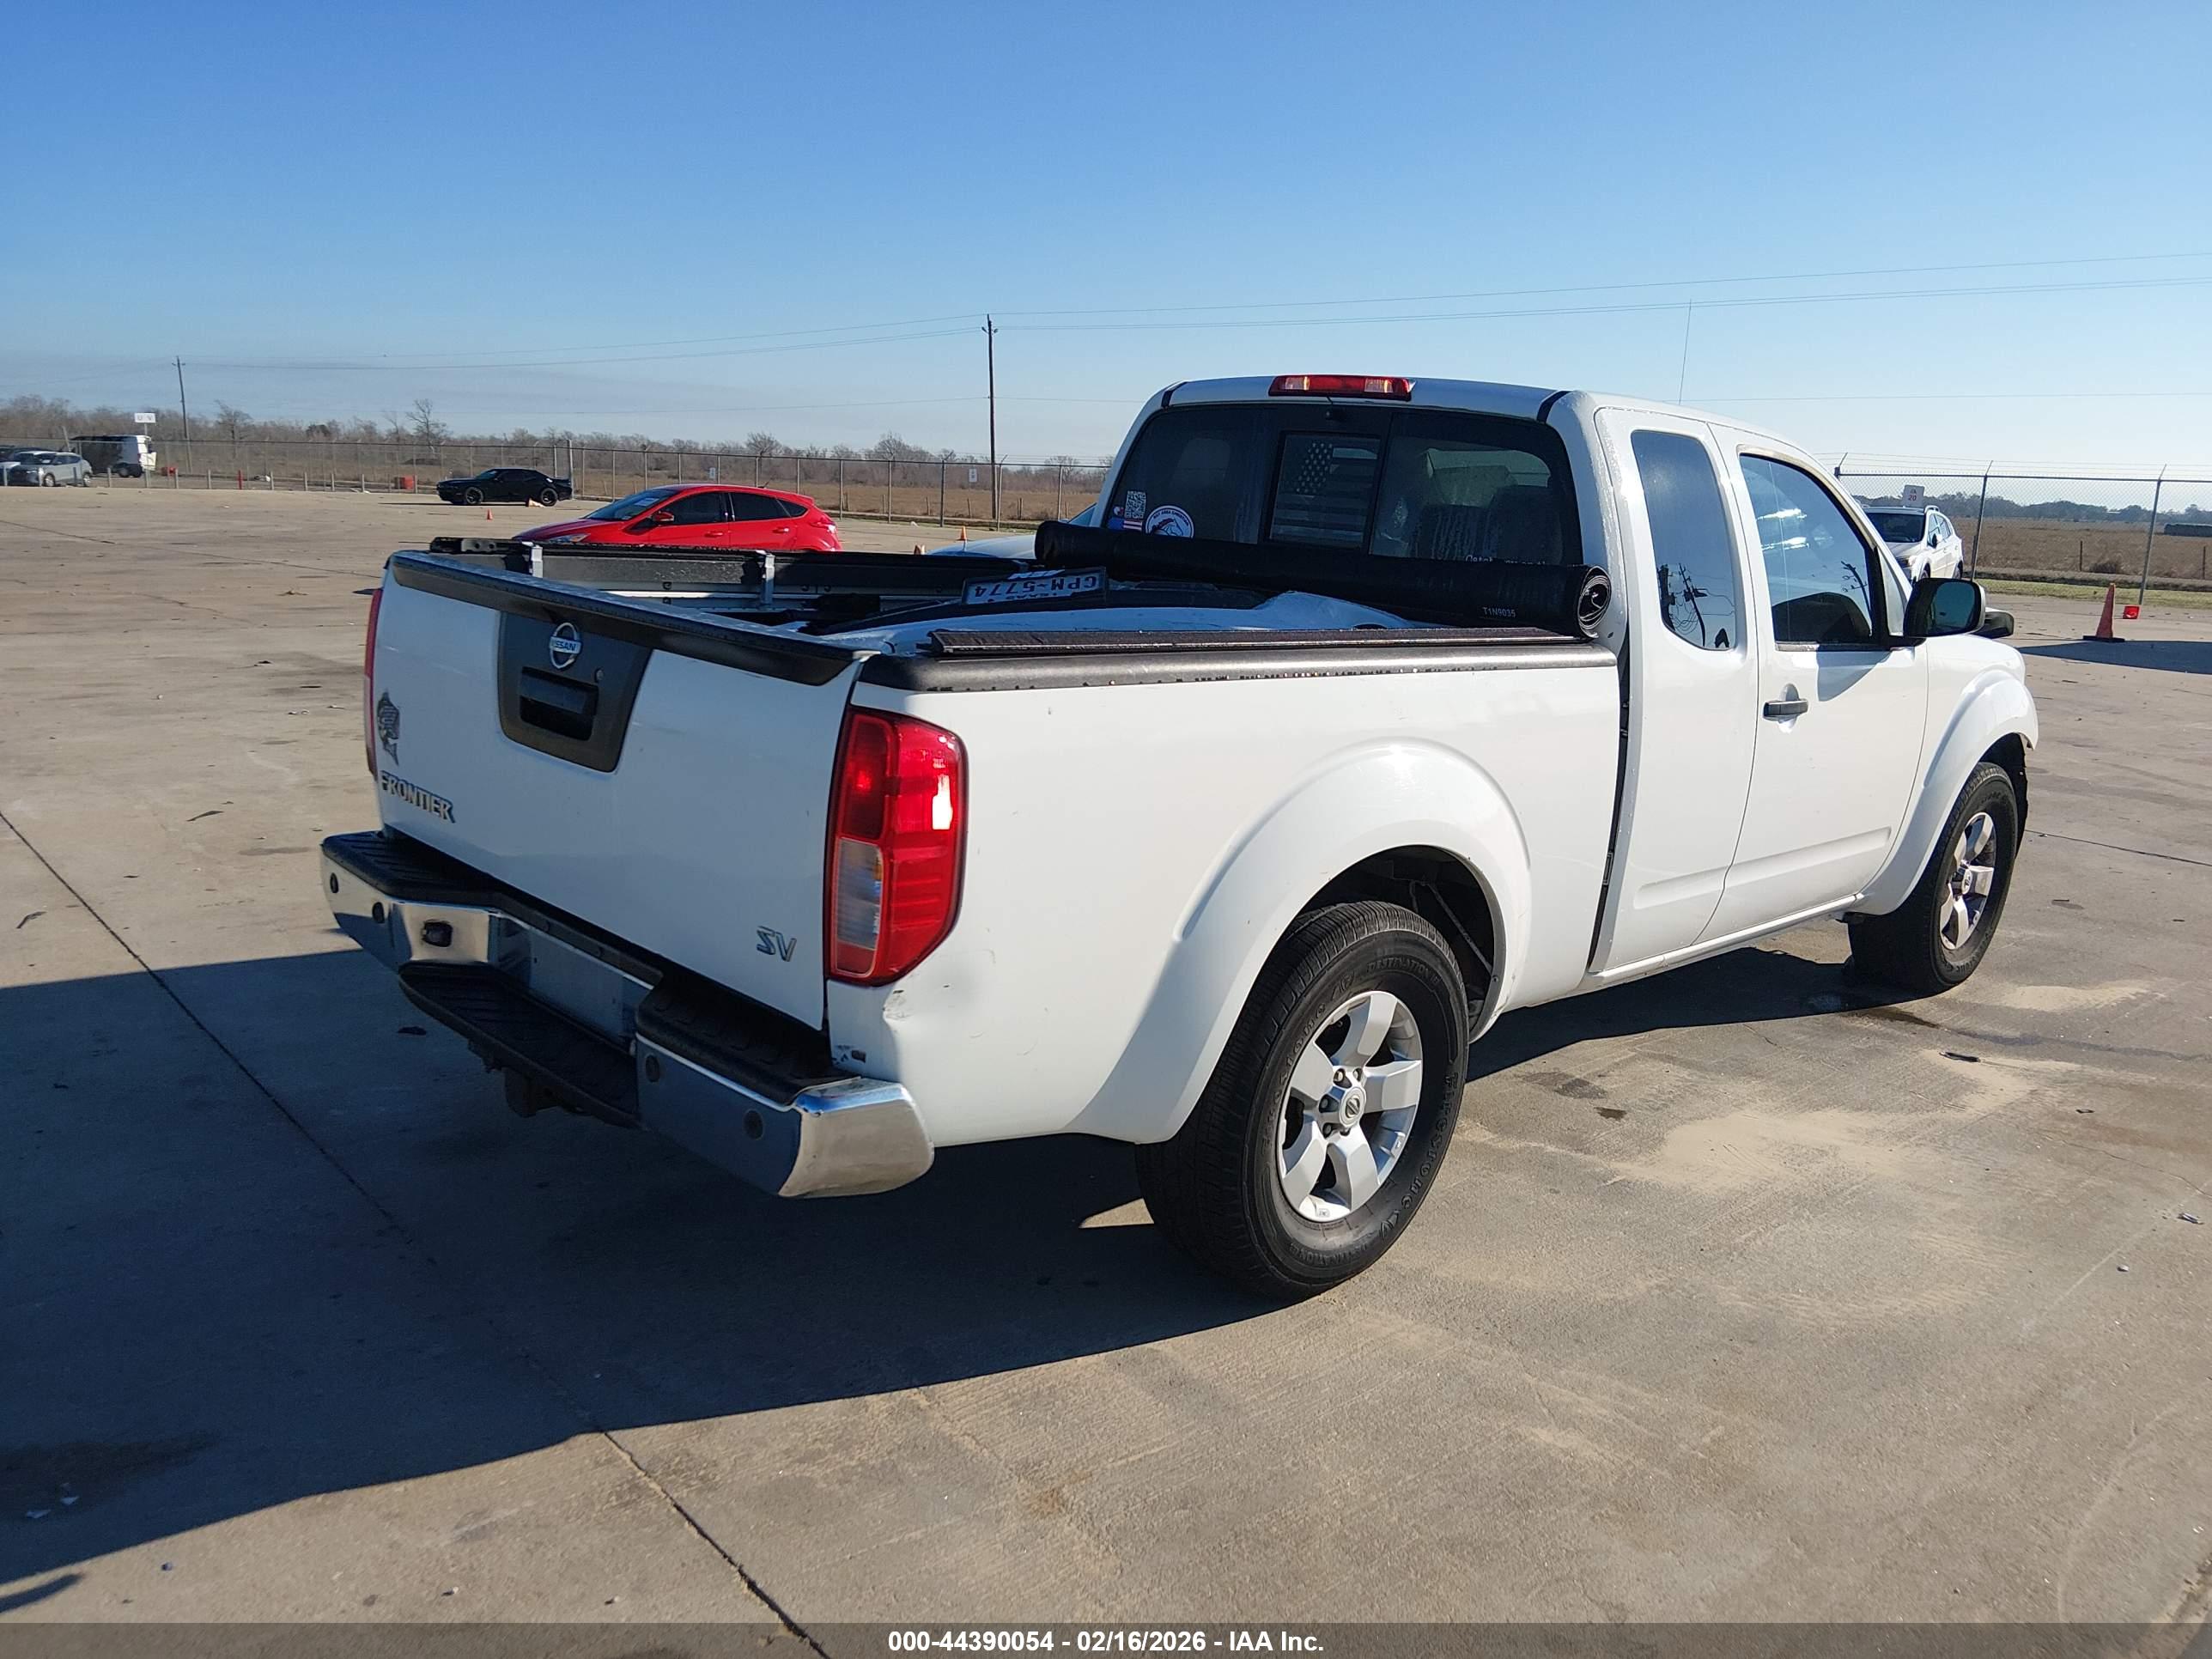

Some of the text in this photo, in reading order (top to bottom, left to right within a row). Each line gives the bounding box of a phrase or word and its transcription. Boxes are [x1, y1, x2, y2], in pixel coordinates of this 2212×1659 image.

[1483, 606, 1516, 617] T1N9035
[380, 770, 456, 823] FRONTIER
[757, 926, 797, 962] SV
[1401, 1075, 1460, 1210] Firestone
